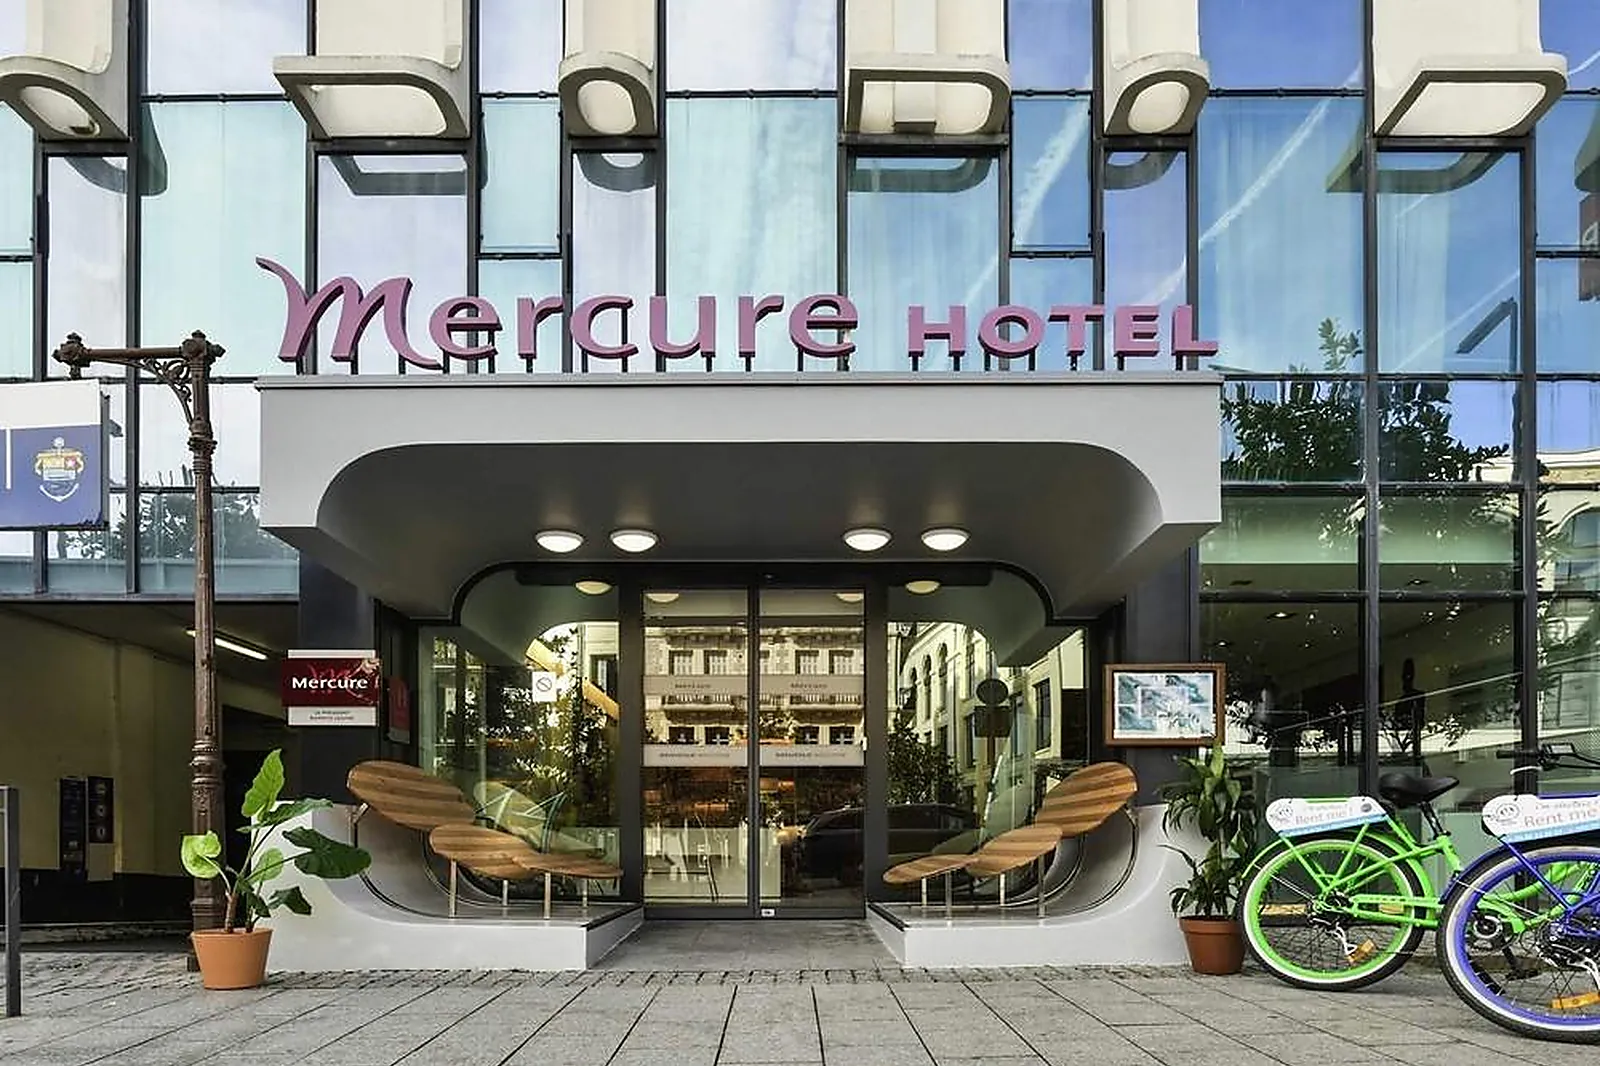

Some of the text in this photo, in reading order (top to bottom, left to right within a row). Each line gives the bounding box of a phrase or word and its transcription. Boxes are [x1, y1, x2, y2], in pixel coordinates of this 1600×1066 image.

[255, 257, 1219, 369] Mercure HOTEL
[291, 676, 369, 689] Mercure
[1524, 813, 1564, 827] Rent
